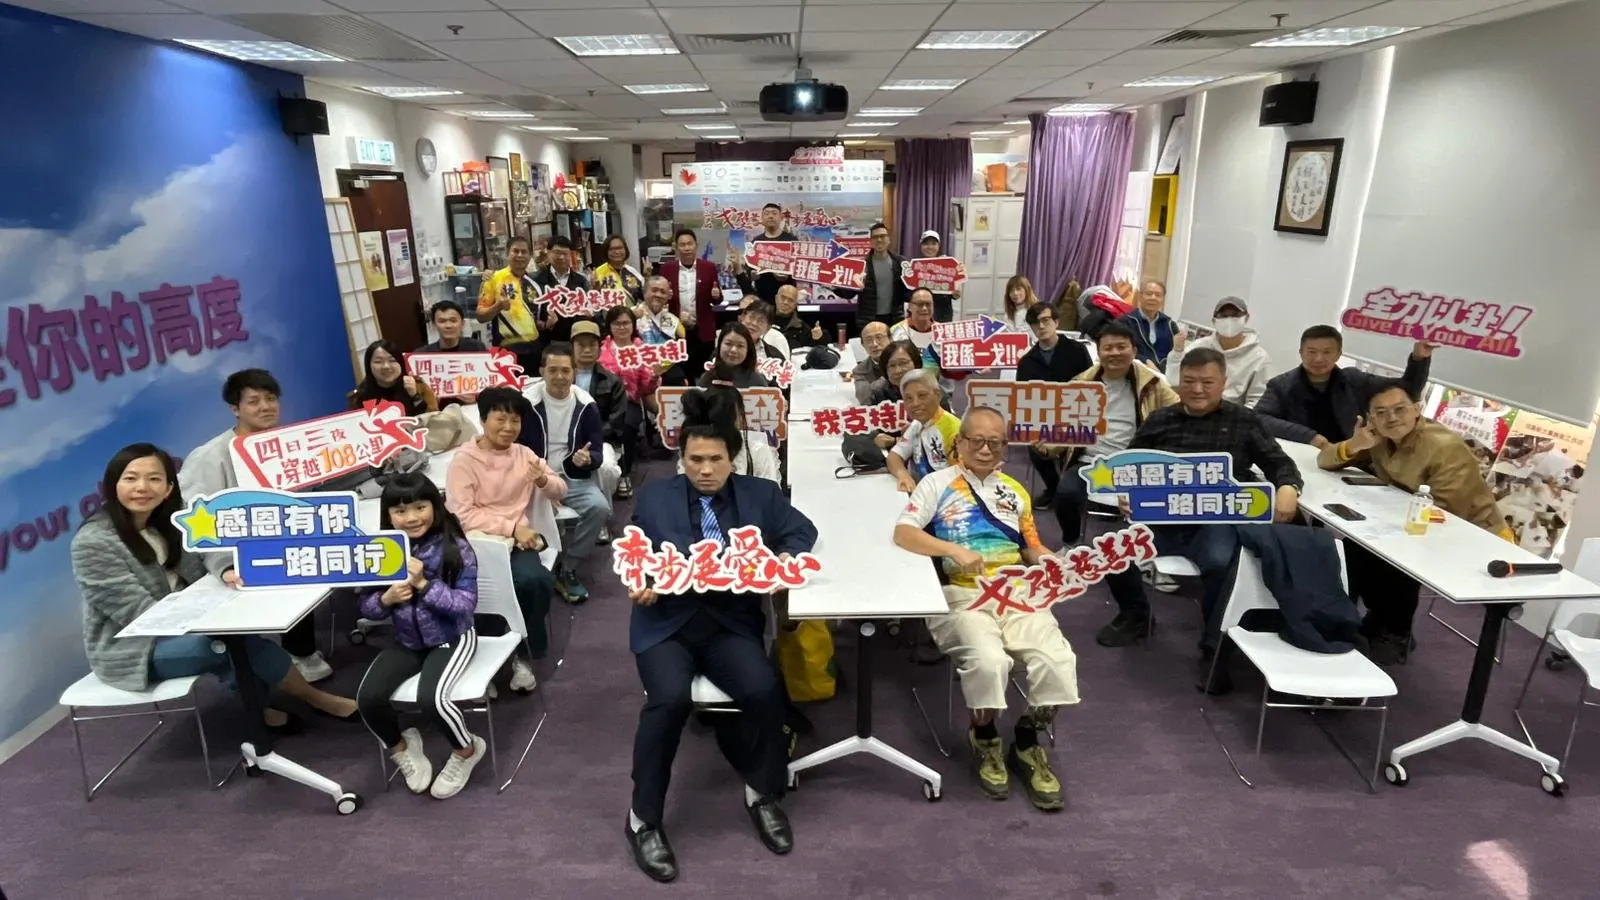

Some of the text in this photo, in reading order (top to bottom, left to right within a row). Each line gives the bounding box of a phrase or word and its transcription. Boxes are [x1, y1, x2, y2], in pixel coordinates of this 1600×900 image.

[794, 259, 854, 286] 我係一戈!!
[934, 320, 985, 341] 戈壁慈善行
[1347, 312, 1393, 331] Give
[1419, 324, 1473, 347] Your
[1361, 288, 1532, 342] 全力以赴!
[0, 276, 249, 408] 你的高度
[618, 340, 687, 368] 我支持!
[943, 342, 1017, 366] 我係一戈!!
[415, 359, 476, 377] 四日三夜
[661, 393, 779, 432] 再發
[812, 402, 906, 437] 我支持!
[254, 428, 346, 465] 四日三夜
[1038, 424, 1097, 444] AGAIN
[280, 435, 385, 485] 穿越108公里
[1112, 462, 1225, 487] 感恩有你
[215, 503, 351, 538] 感恩有你
[1139, 492, 1254, 516] 一路同行
[250, 543, 387, 577] 一路同行
[616, 528, 821, 590] 齊步展愛心
[966, 527, 1154, 616] 戈壁慈善行
